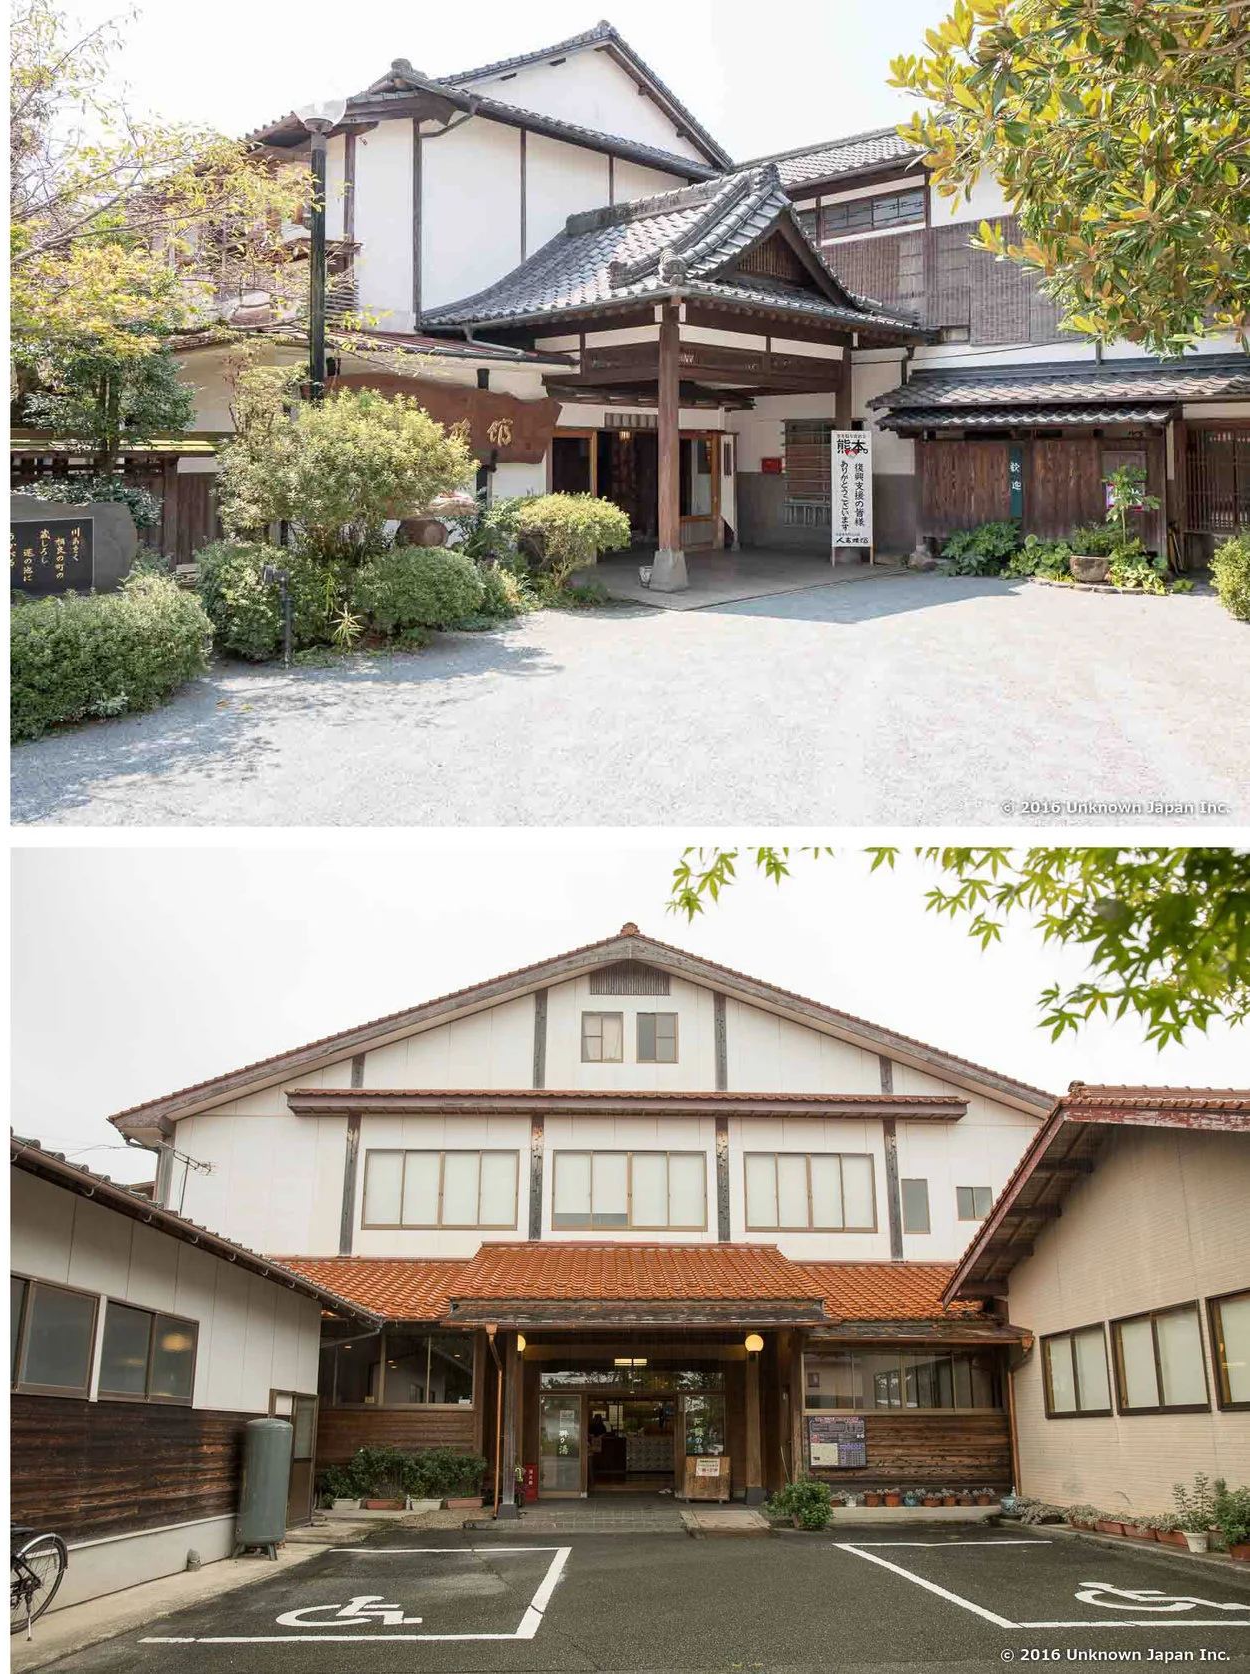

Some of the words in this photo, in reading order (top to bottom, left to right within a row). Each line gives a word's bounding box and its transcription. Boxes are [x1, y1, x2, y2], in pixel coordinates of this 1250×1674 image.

[840, 460, 849, 532] ありがとうございます
[854, 462, 865, 527] 復興支援の皆様
